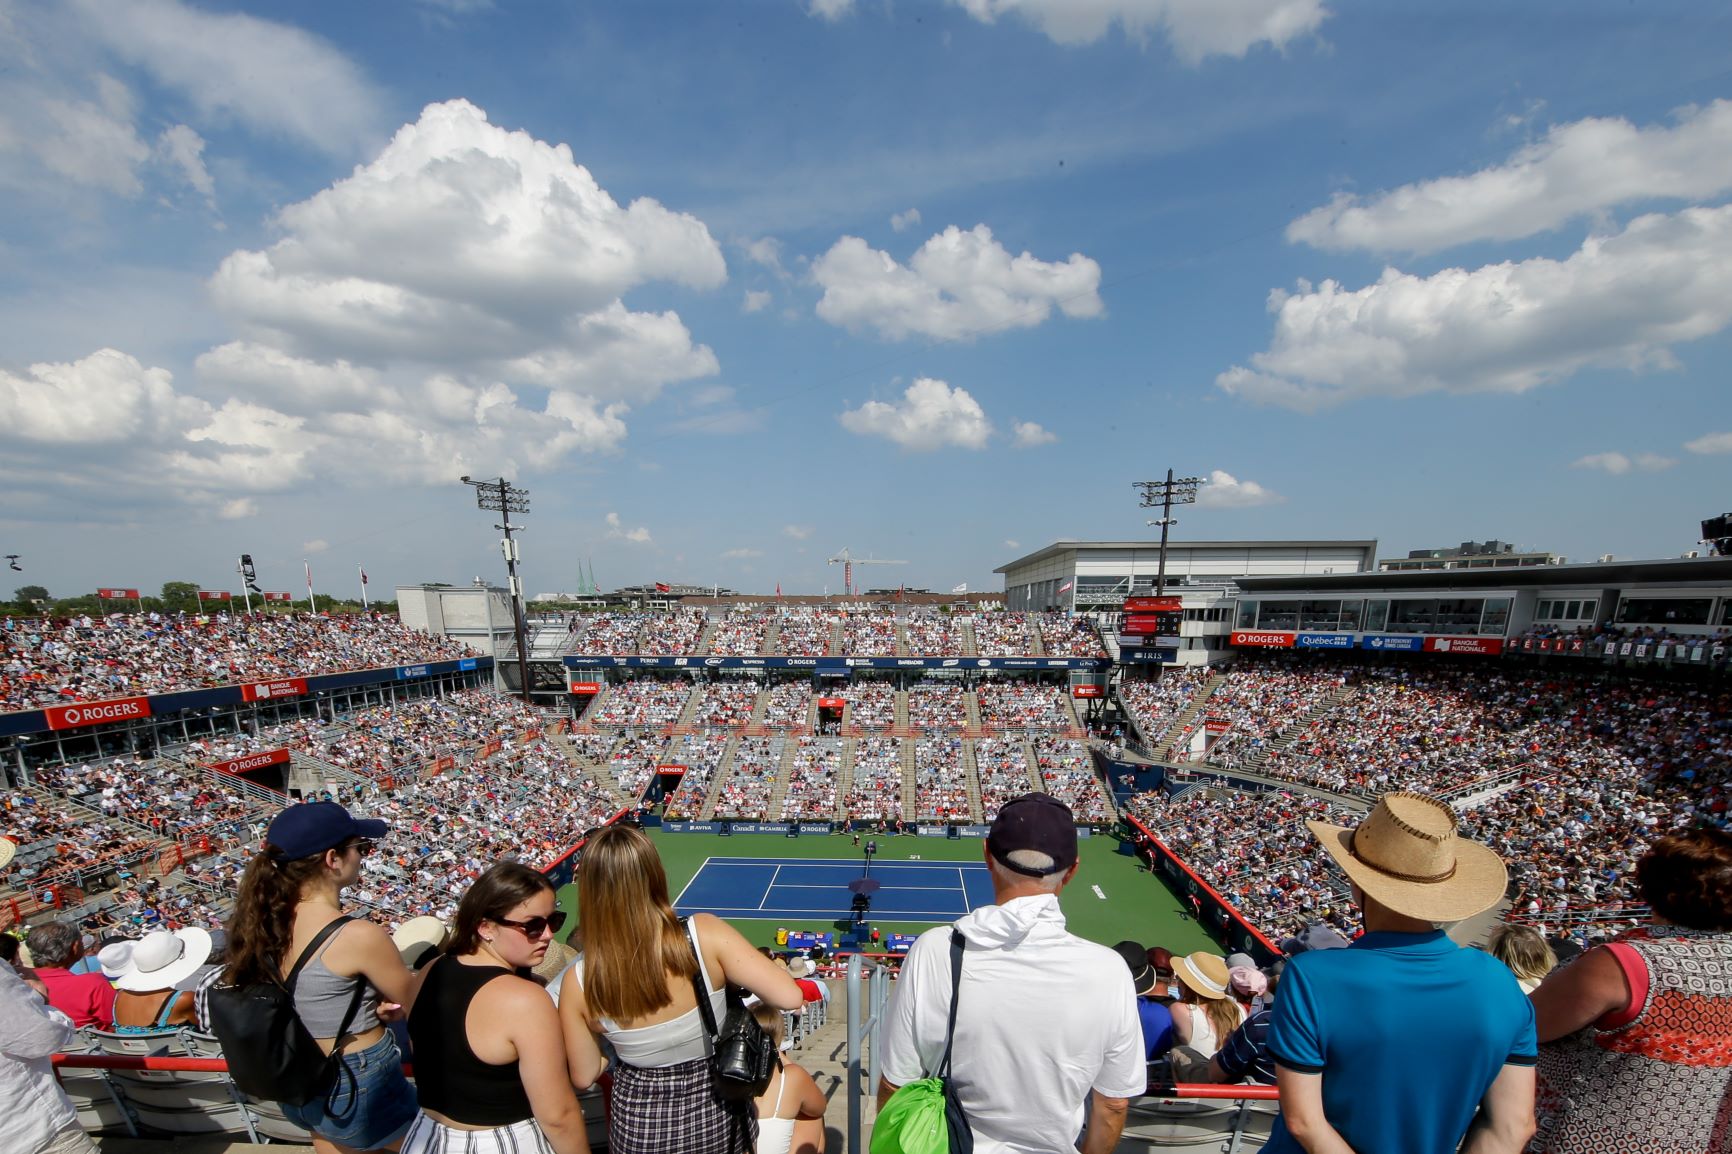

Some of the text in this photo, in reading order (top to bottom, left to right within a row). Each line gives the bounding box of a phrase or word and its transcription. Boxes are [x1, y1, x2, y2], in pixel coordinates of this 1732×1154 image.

[1247, 635, 1285, 644] ROGERS
[1302, 636, 1334, 645] Québec
[1453, 639, 1479, 647] BANQUE
[1451, 645, 1487, 653] NATIONALE
[1143, 652, 1163, 660] IRIS
[271, 681, 291, 690] BANQUE
[271, 686, 299, 696] NATIONALE
[83, 702, 139, 722] ROGERS
[238, 755, 273, 771] ROGERS
